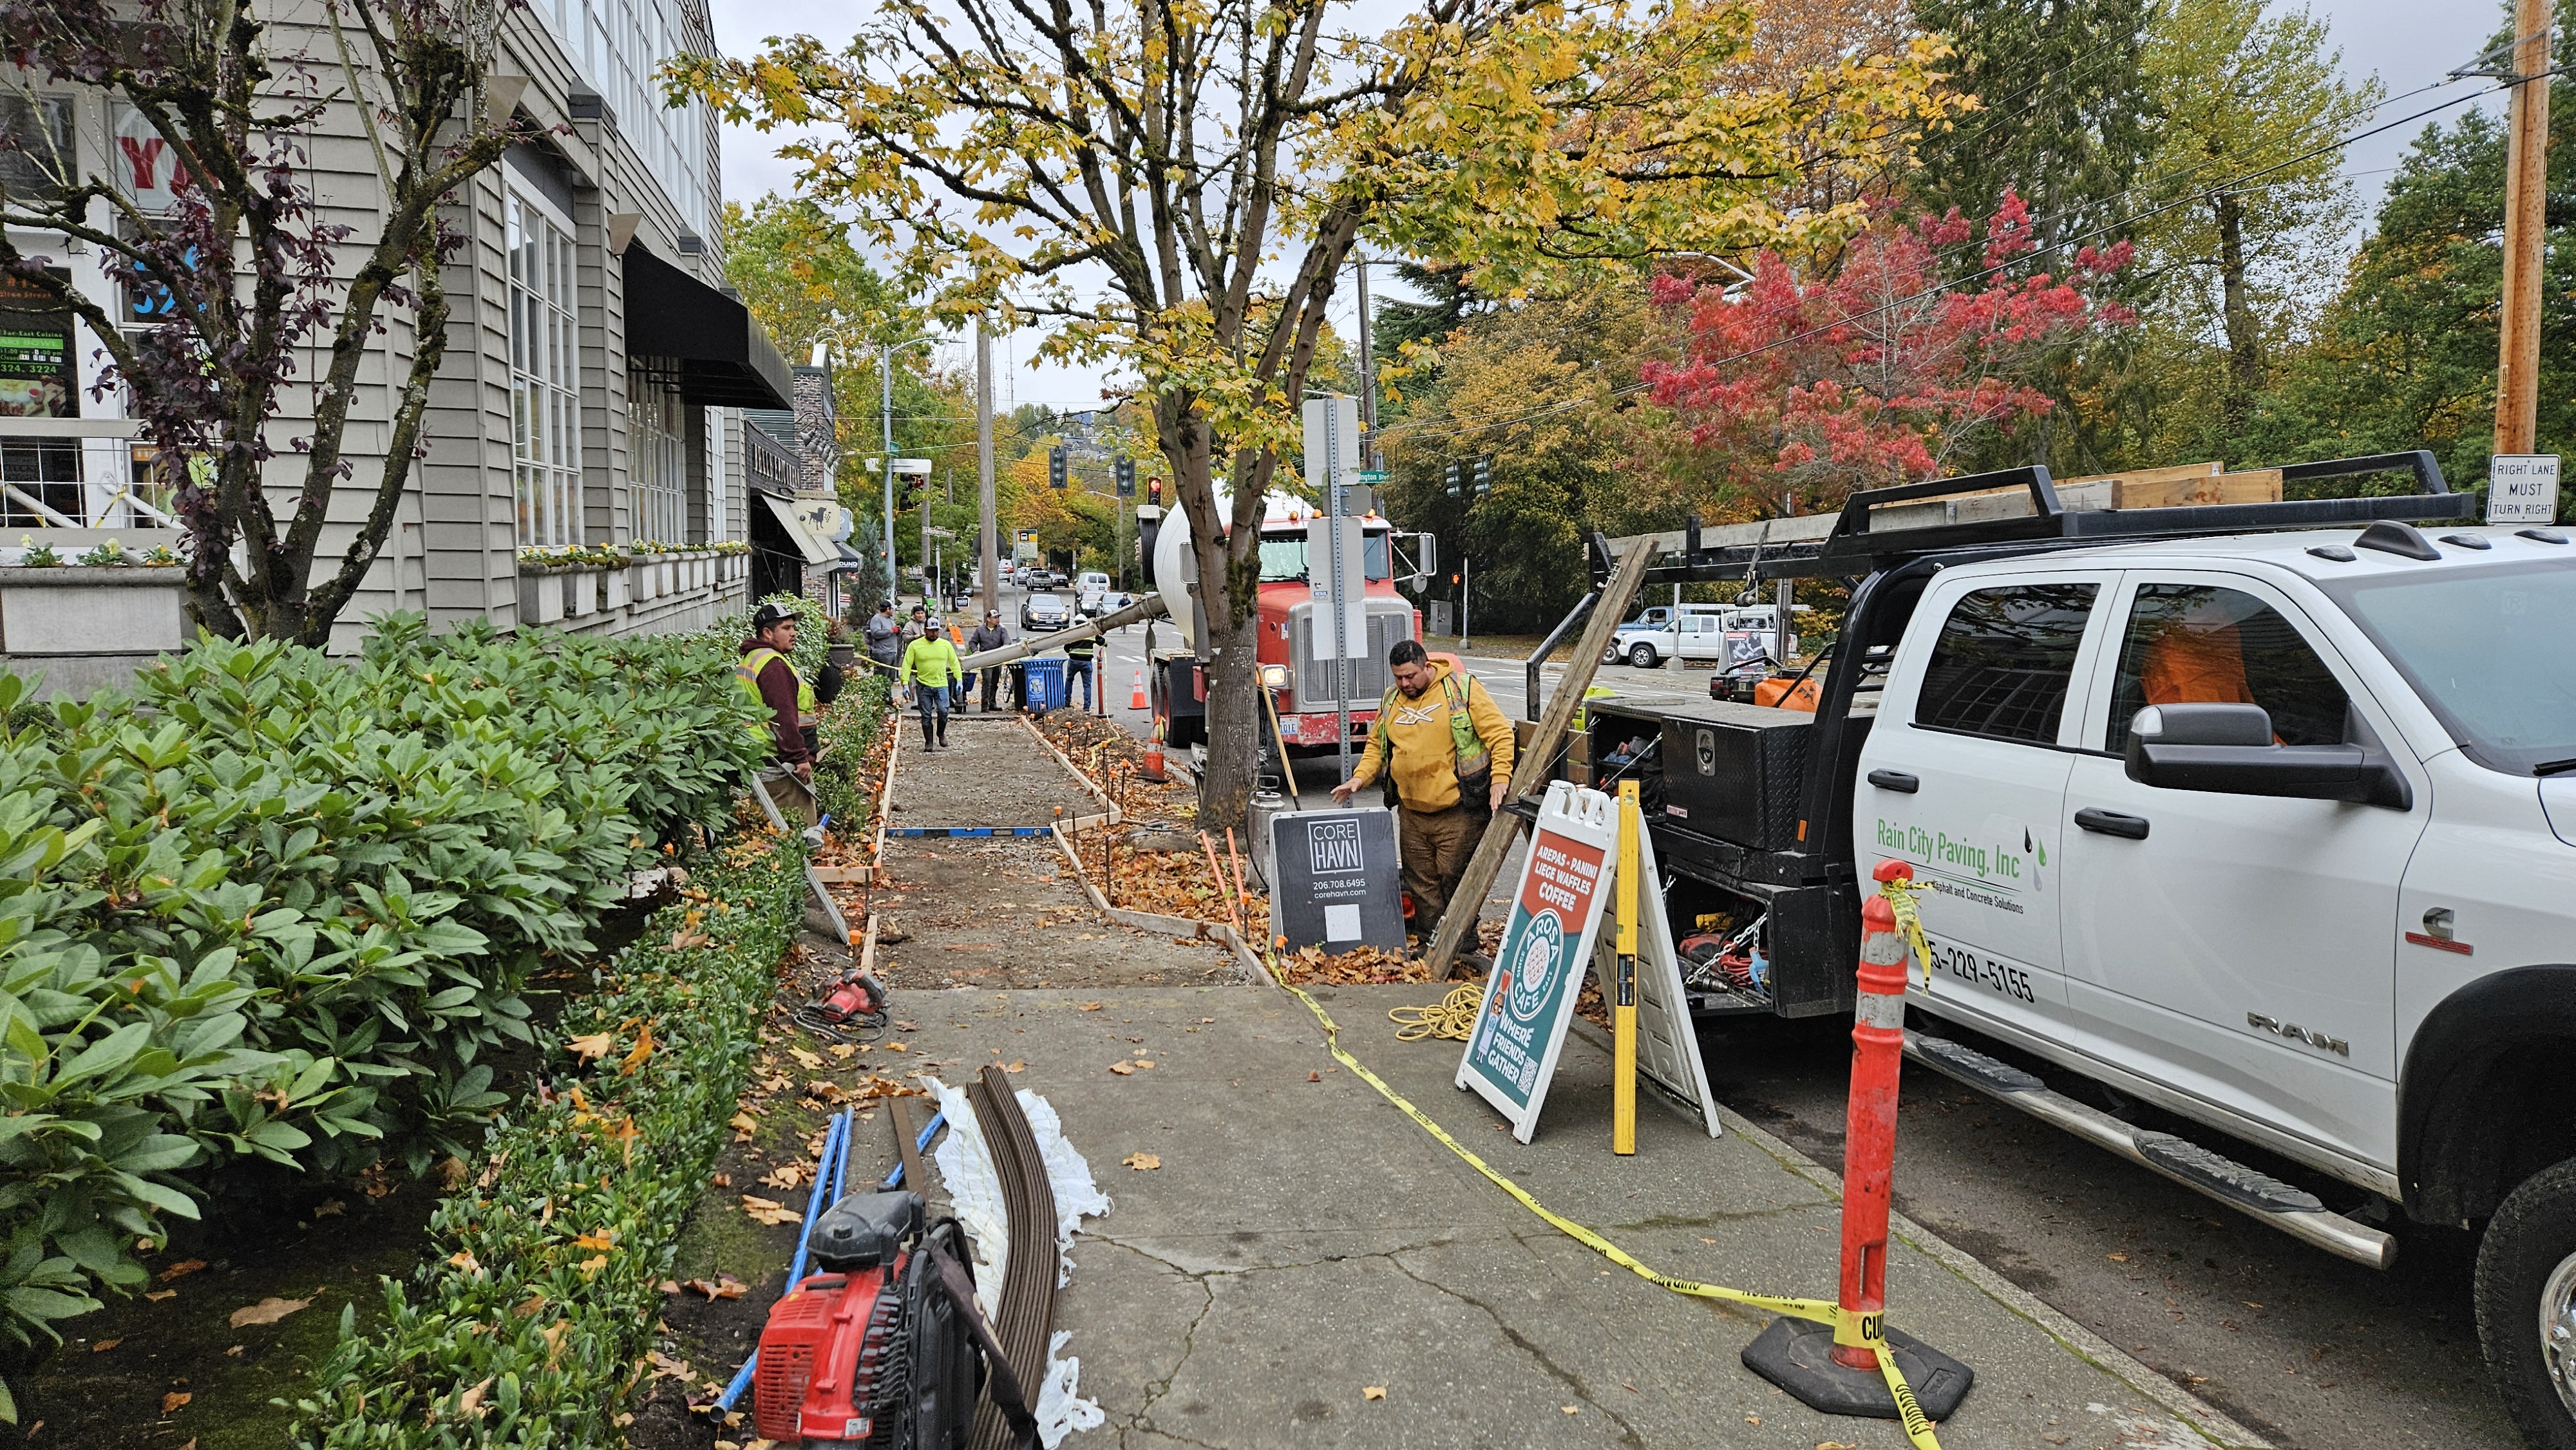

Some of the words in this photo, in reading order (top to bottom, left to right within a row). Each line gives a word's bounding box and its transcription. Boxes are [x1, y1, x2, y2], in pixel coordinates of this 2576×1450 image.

[2497, 464, 2528, 475] RIGHT
[2532, 464, 2555, 475] LANE
[2509, 484, 2543, 496] MUST
[2494, 504, 2520, 514] TURN
[2525, 504, 2552, 515] RIGHT
[1313, 824, 1356, 840] CORE
[1314, 839, 1358, 869] HAVN
[1536, 845, 1567, 867] AREPAS
[1569, 857, 1598, 880] PANINI
[1877, 818, 1904, 851] Rain
[1909, 825, 1933, 864] City
[1938, 831, 1990, 878] Paving,
[1996, 844, 2020, 878] Inc
[1313, 878, 1366, 890] 206.708.6495
[1314, 889, 1367, 899] corehavn.com
[1534, 861, 1557, 881] LIEGE
[1556, 869, 1591, 896] WAFFLES
[1539, 881, 1577, 912] COFFEE
[1954, 885, 1965, 898] and
[1966, 888, 1993, 906] Concrete
[1994, 896, 2023, 914] Solutions
[1527, 917, 1559, 963] AROSA
[1516, 950, 1526, 978] SINCE
[1913, 939, 2035, 1004] 5-229-5155
[1515, 981, 1539, 1012] CAFE
[1499, 1008, 1535, 1048] WHERE
[2247, 1011, 2350, 1057] RAM
[1493, 1031, 1526, 1066] FRIENDS
[1488, 1049, 1520, 1085] GATHER
